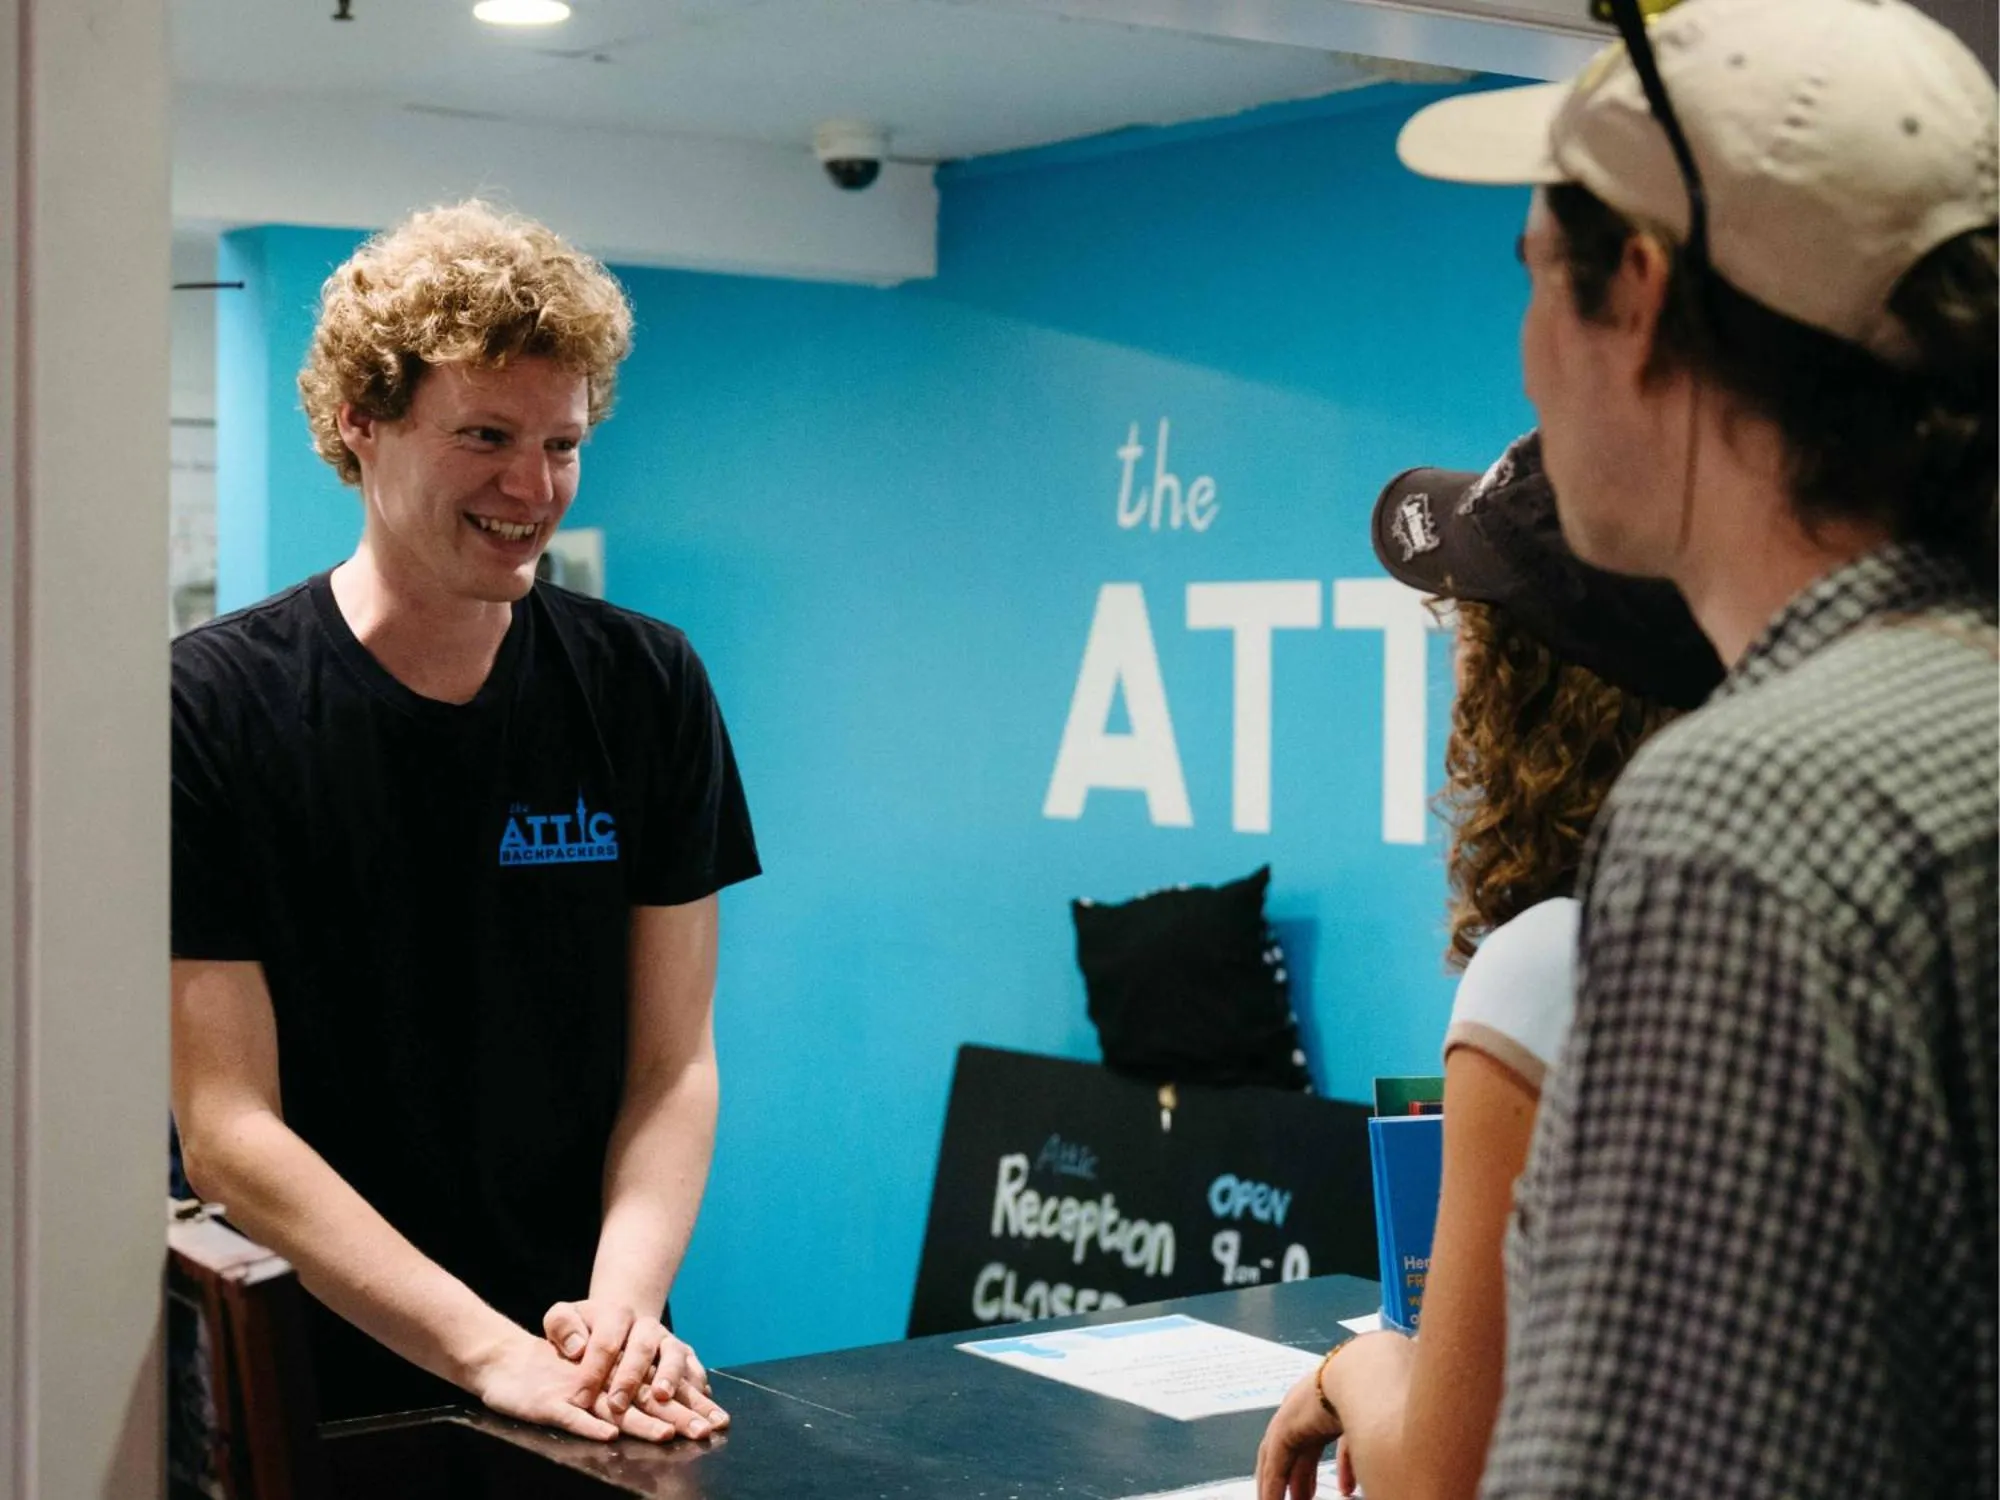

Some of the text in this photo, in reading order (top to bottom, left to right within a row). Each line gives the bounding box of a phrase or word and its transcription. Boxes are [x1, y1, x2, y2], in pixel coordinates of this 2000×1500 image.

[1117, 416, 1220, 531] the
[501, 790, 616, 847] ATTIC
[502, 845, 616, 862] BACKPACKERS
[991, 1153, 1176, 1277] Reception
